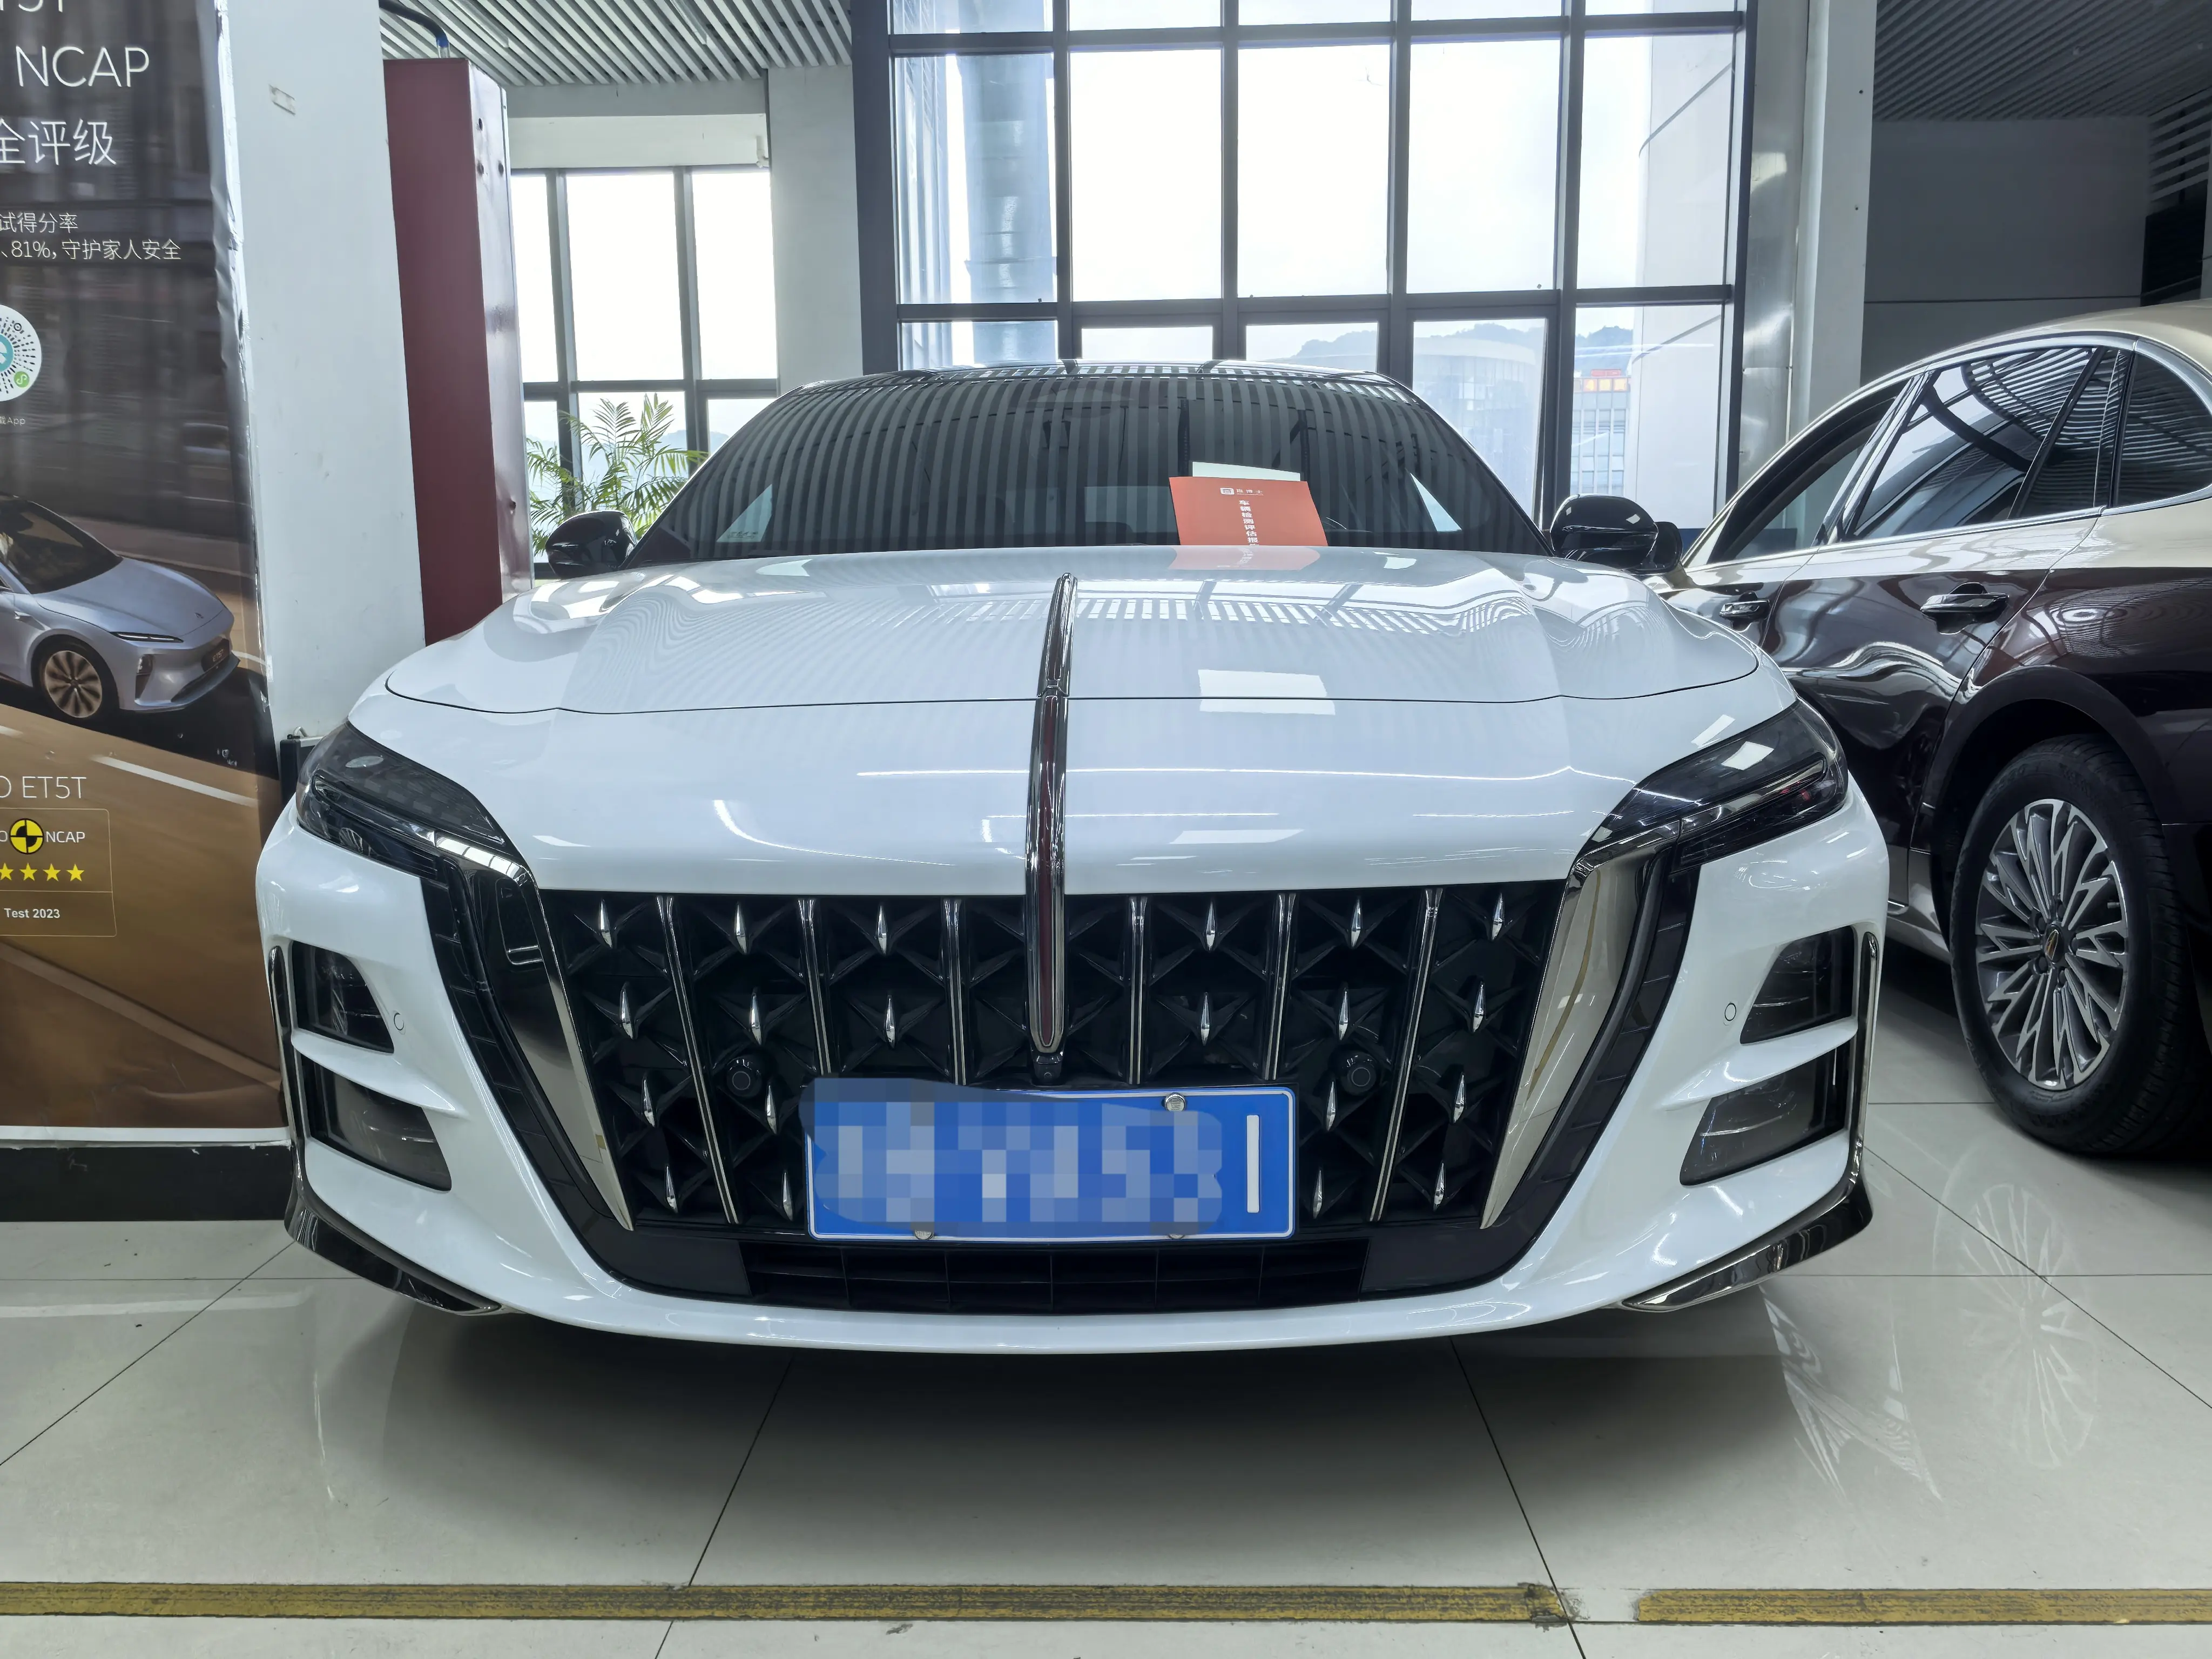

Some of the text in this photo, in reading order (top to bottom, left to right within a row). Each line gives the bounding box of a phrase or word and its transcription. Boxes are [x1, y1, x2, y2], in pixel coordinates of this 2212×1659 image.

[16, 45, 149, 87] NCAP
[0, 118, 117, 165] 全评级
[22, 776, 87, 799] ET5T
[46, 831, 85, 843] NCAP
[4, 908, 60, 919] Test 2023
